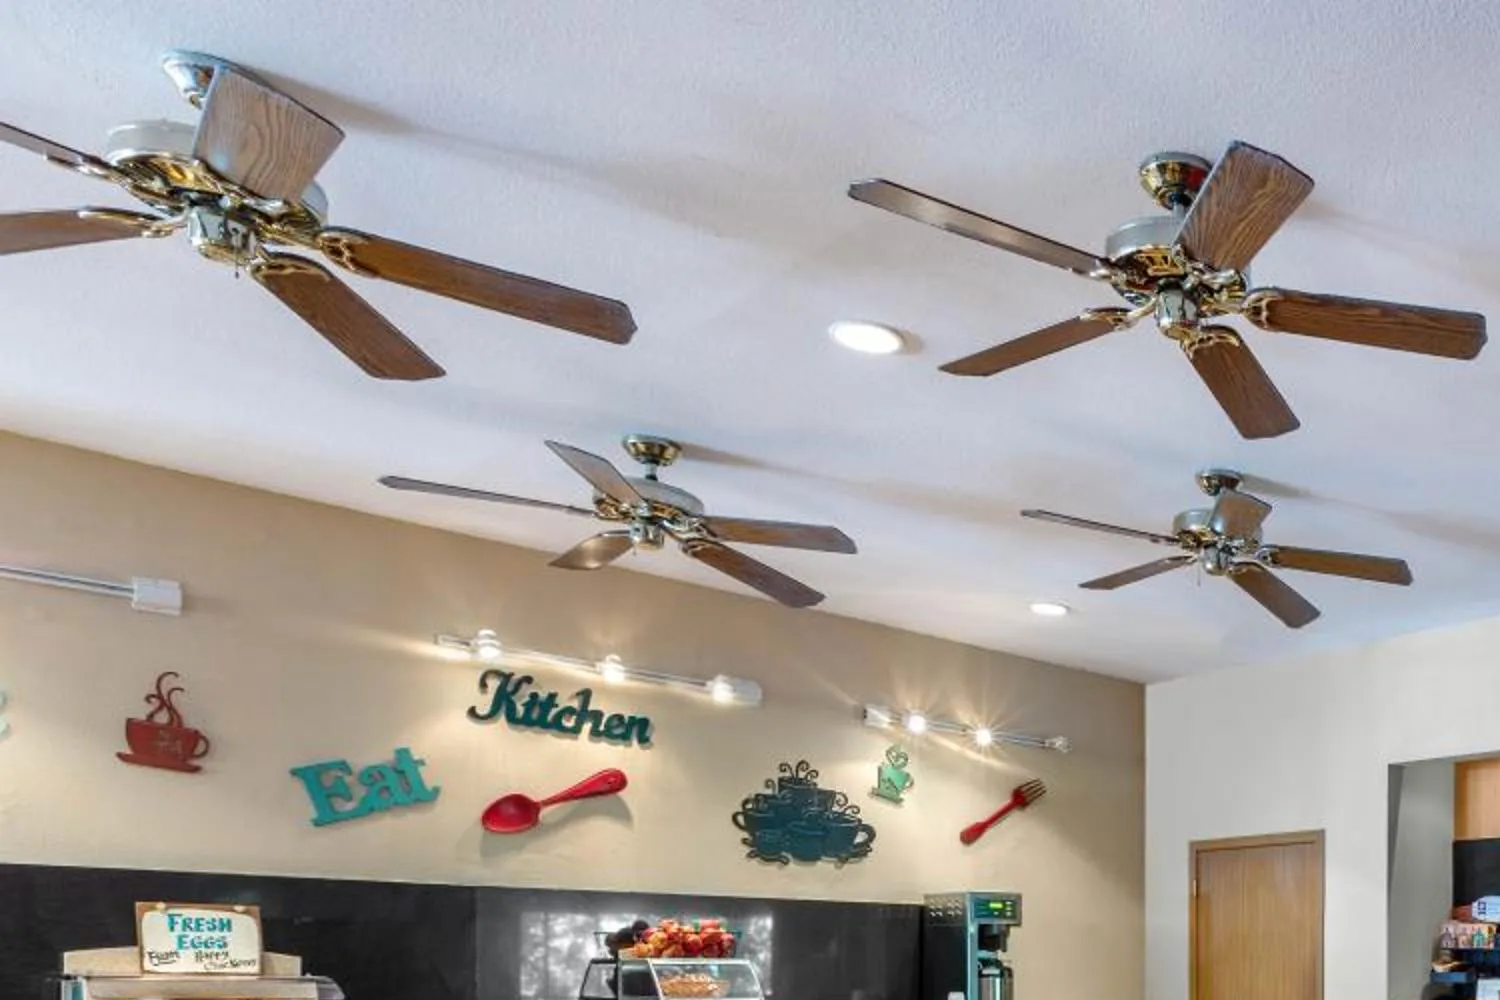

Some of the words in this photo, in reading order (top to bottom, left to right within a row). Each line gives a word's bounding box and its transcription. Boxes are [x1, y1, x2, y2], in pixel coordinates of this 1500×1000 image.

[467, 669, 651, 744] Kitchen
[289, 747, 440, 827] Eat
[167, 913, 232, 933] FRESH
[176, 934, 228, 951] EGGS
